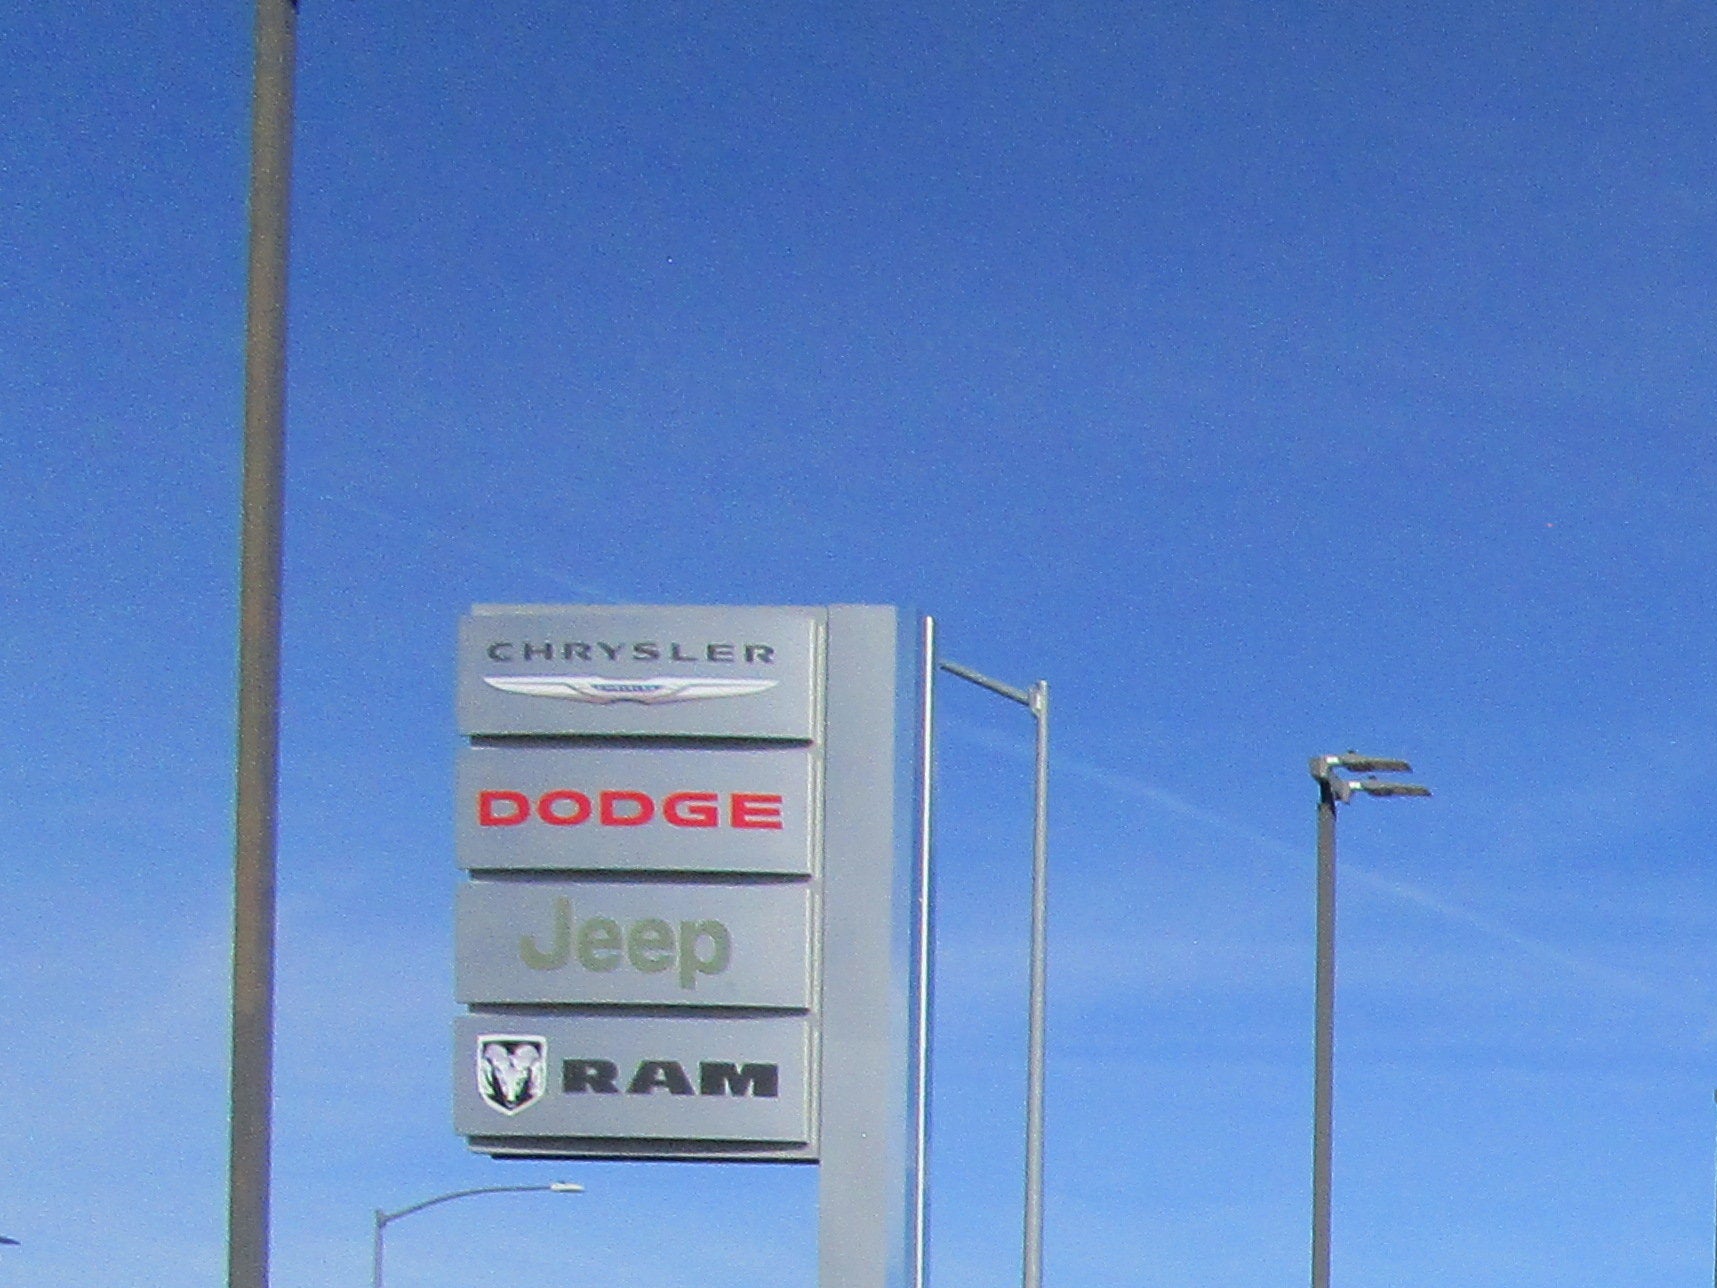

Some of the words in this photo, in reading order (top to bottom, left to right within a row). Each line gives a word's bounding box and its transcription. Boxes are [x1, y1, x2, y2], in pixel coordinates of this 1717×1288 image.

[486, 641, 776, 664] CHRYSLER
[478, 790, 784, 829] DODGE
[519, 898, 731, 989] Jeep
[561, 1058, 779, 1098] RAM
